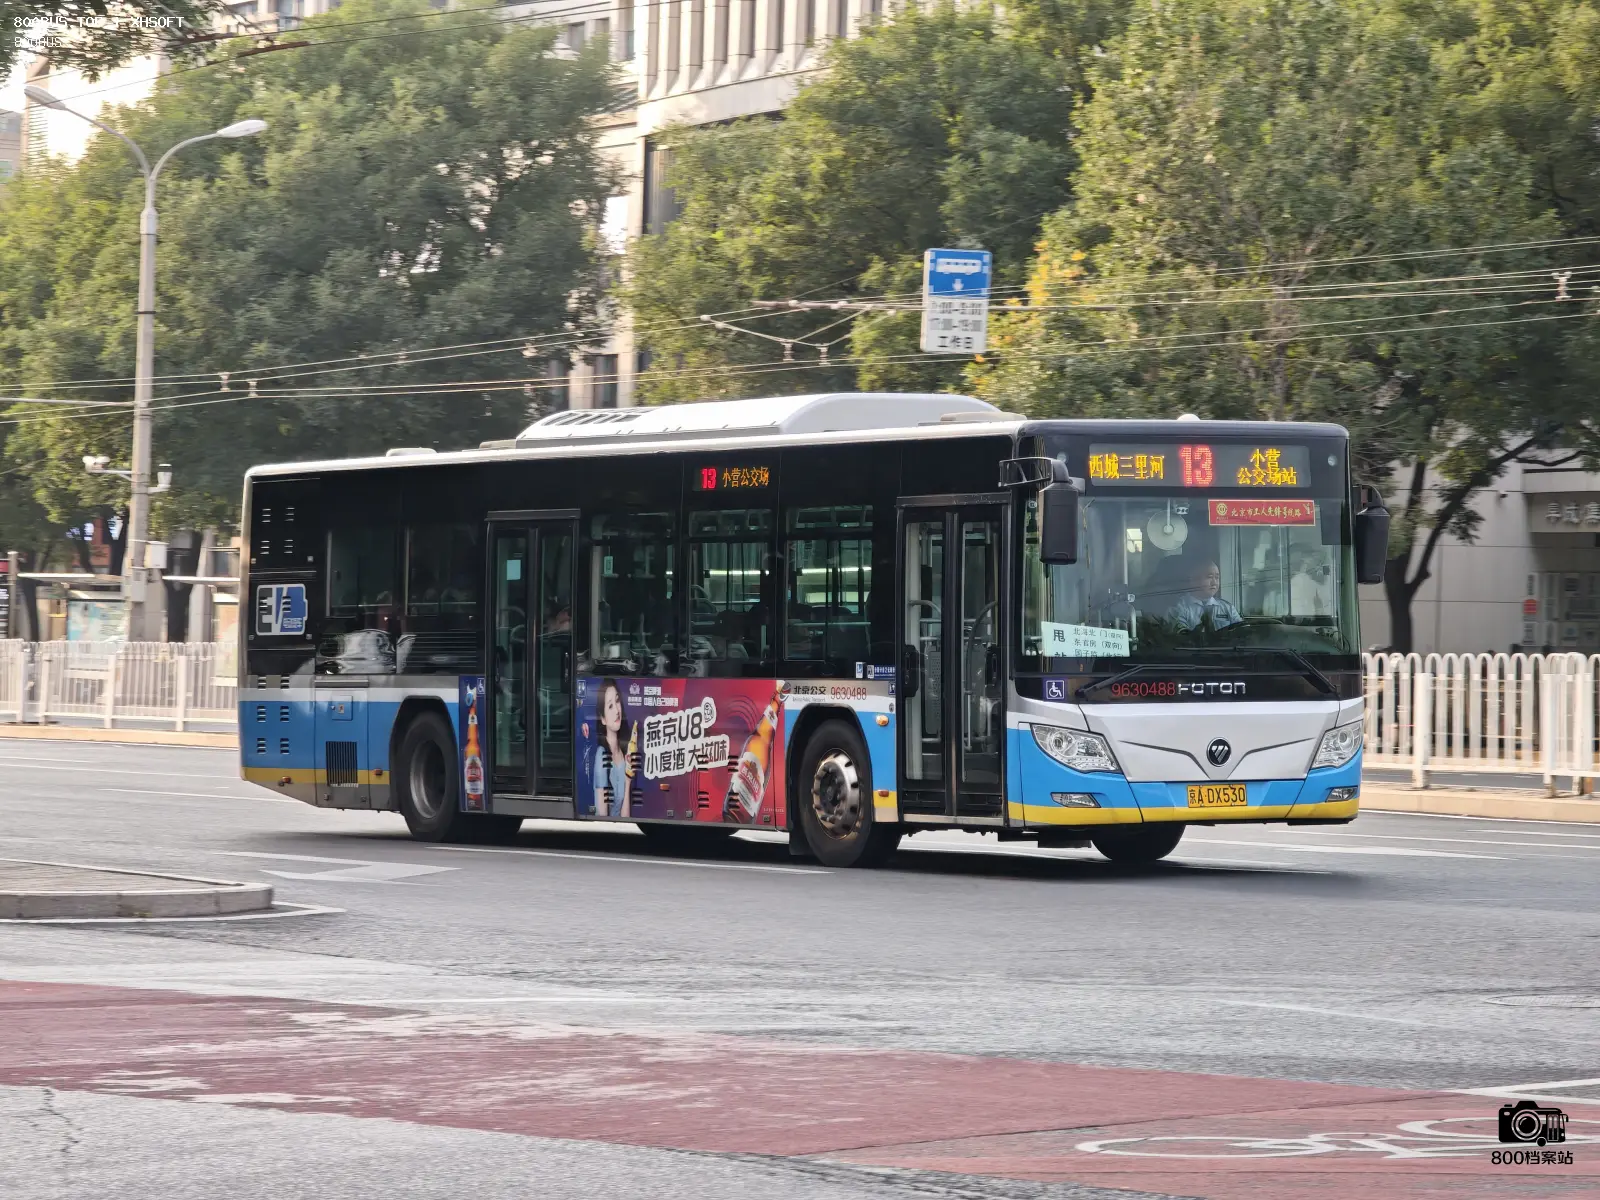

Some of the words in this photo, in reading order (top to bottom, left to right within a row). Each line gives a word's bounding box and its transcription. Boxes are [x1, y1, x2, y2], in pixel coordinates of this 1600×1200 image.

[702, 468, 717, 489] 13
[722, 466, 770, 488] 小营公交场
[1088, 452, 1165, 480] 西城三里河
[1179, 445, 1214, 487] 13
[1249, 448, 1282, 468] 小营
[1236, 467, 1298, 486] 公交场站
[793, 686, 827, 695] 北京公交
[830, 686, 867, 701] 9630488
[1111, 682, 1176, 697] 9630488
[1177, 682, 1246, 695] FOTON
[646, 711, 703, 748] 燕京U8
[646, 747, 686, 774] 小度酒
[688, 739, 728, 767] 大滋味
